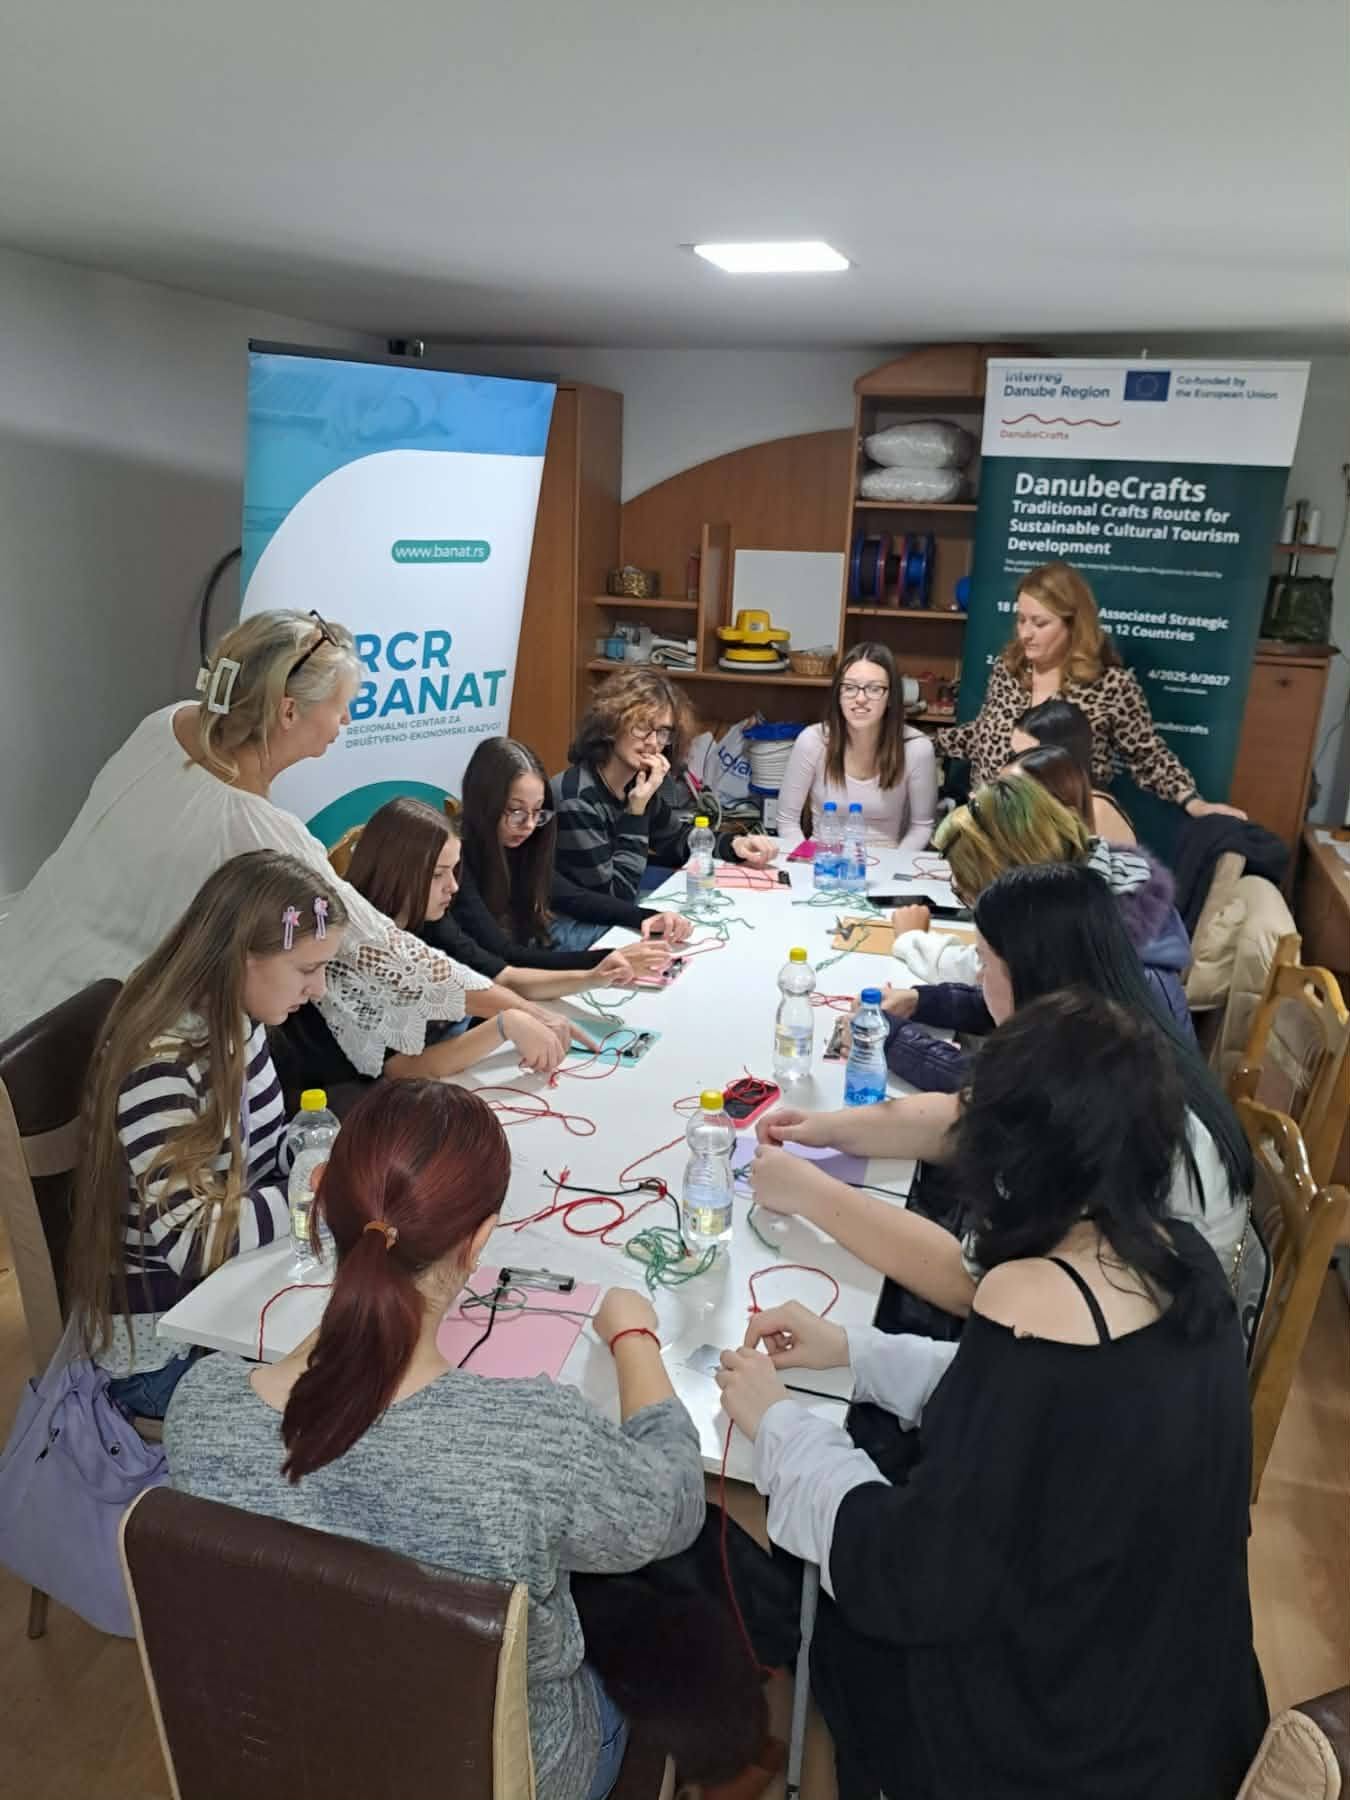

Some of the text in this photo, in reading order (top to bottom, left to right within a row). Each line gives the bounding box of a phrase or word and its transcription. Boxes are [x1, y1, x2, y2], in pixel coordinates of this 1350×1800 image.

[1233, 376, 1247, 387] by
[1004, 384, 1110, 400] Danube Region
[1247, 391, 1279, 400] Union
[1000, 429, 1069, 440] DanubeCrafts
[1014, 472, 1207, 503] DanubeCrafts
[1012, 500, 1231, 524] Traditional Crafts Route for
[1009, 518, 1241, 545] Sustainable Cultural Tourism
[395, 545, 485, 559] www.banat.rs
[1007, 537, 1112, 556] Development
[997, 601, 1011, 613] 18
[1098, 608, 1230, 632] Associated Strategic
[1115, 624, 1129, 636] 12
[1131, 625, 1196, 642] Countries
[354, 630, 452, 673] RCR
[350, 669, 506, 721] BANAT
[410, 717, 446, 729] CENTAR
[448, 715, 461, 724] ZA
